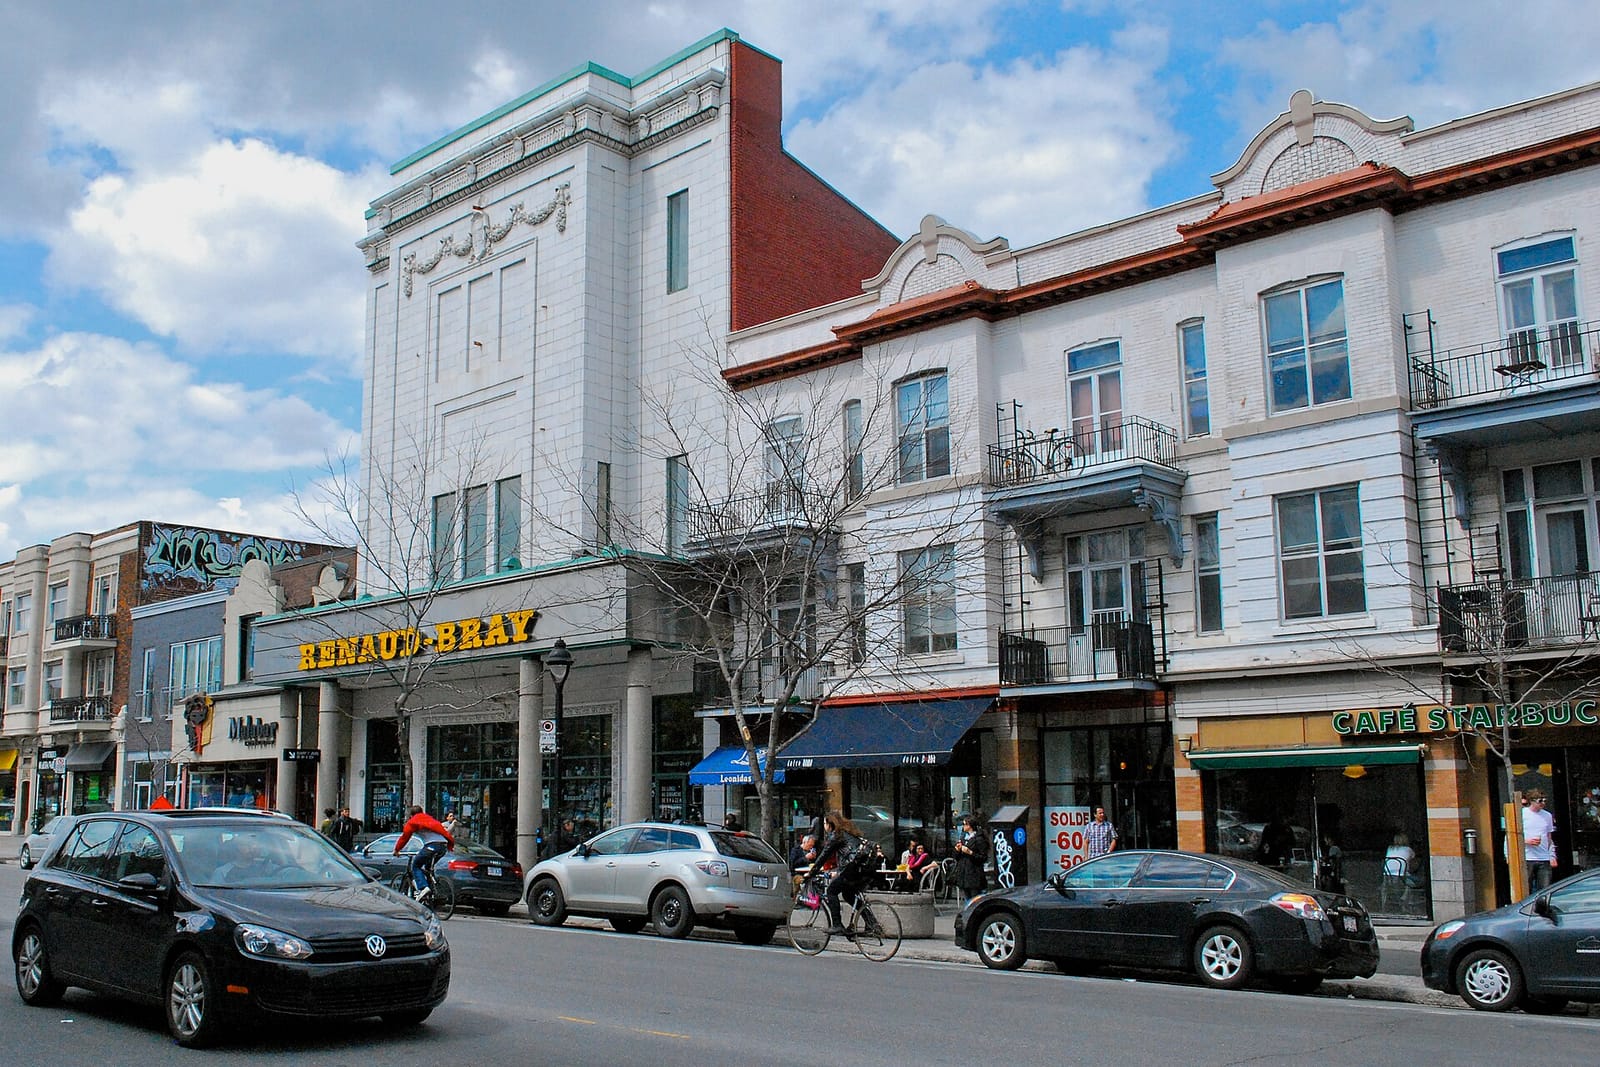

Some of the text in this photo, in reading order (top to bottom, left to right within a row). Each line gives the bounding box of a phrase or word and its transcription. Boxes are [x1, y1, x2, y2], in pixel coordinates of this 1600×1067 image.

[297, 609, 536, 671] RENAUD-BRAY
[1331, 702, 1417, 735] CAFÉ
[720, 774, 752, 783] Leonidas
[1050, 812, 1089, 826] SOLDE
